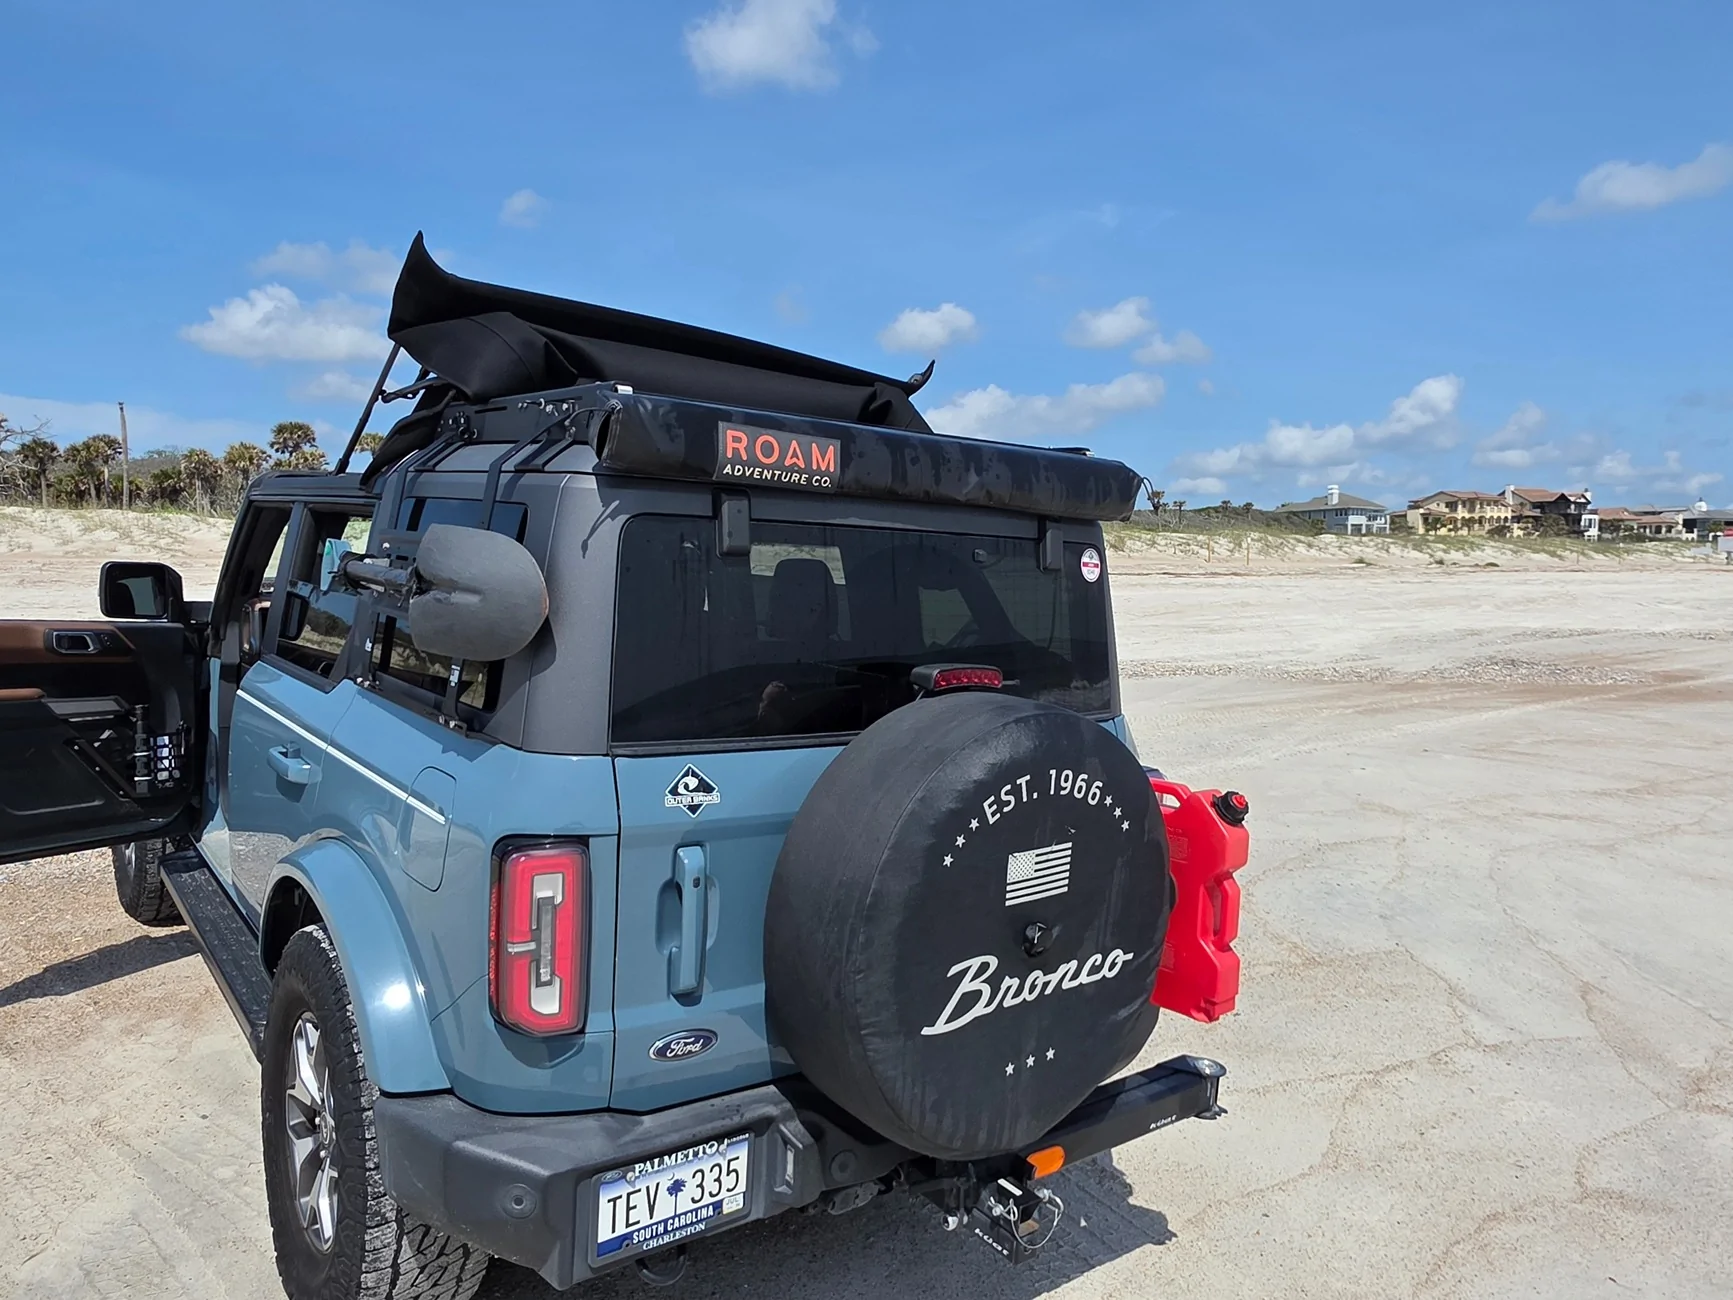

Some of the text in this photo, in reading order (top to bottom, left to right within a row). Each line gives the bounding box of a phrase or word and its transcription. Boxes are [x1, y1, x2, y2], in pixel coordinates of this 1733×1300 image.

[725, 428, 836, 474] ROAM
[722, 463, 832, 488] ADVENTURE CO.
[667, 794, 718, 806] OUTER BANKS
[982, 768, 1104, 825] EST. 1966
[920, 948, 1135, 1036] Bronco
[666, 1037, 703, 1059] Ford
[634, 1140, 719, 1177] PALMETTO
[607, 1156, 740, 1235] TEV 335
[632, 1205, 715, 1244] SOUTH CAROLINA
[642, 1221, 707, 1251] CHARLESTON
